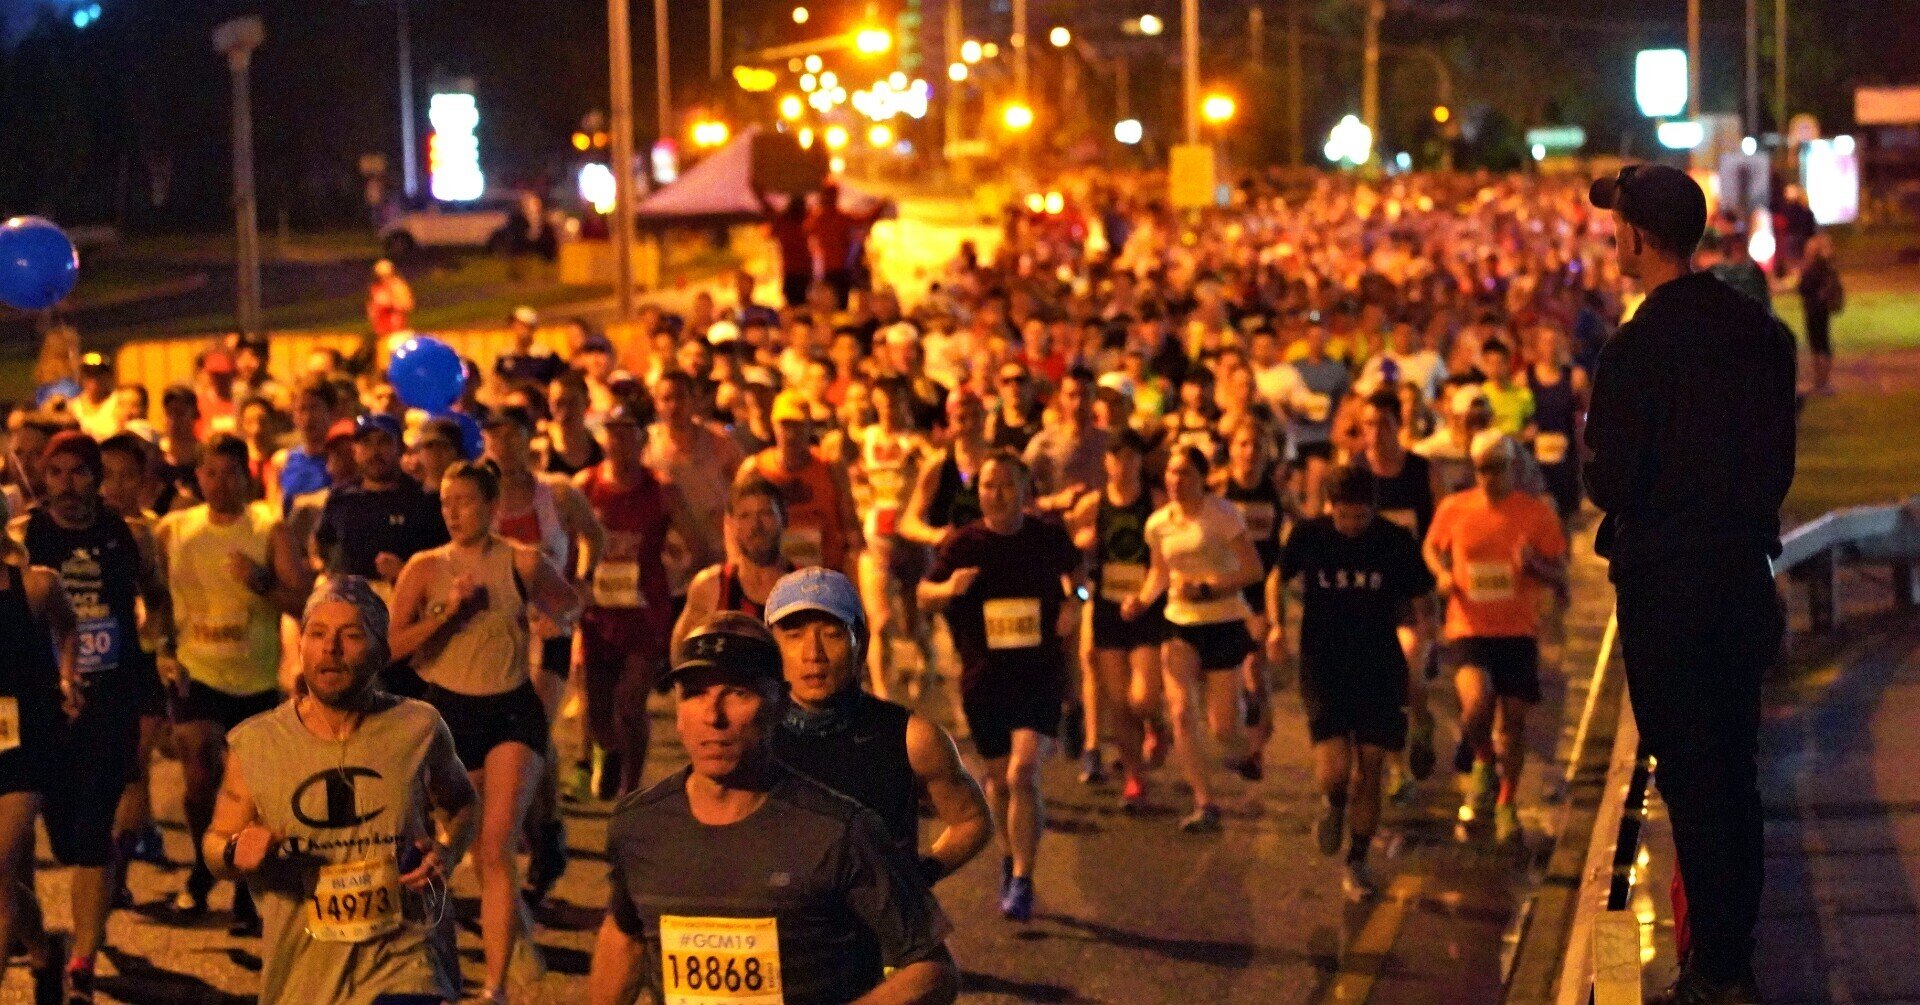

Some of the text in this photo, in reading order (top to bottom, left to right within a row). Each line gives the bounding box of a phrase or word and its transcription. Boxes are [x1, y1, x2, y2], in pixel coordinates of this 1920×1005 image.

[80, 631, 111, 655] 30
[331, 873, 372, 890] BLAIR
[311, 886, 392, 921] 14973
[680, 933, 756, 950] #GCM19
[668, 954, 763, 993] 18868
